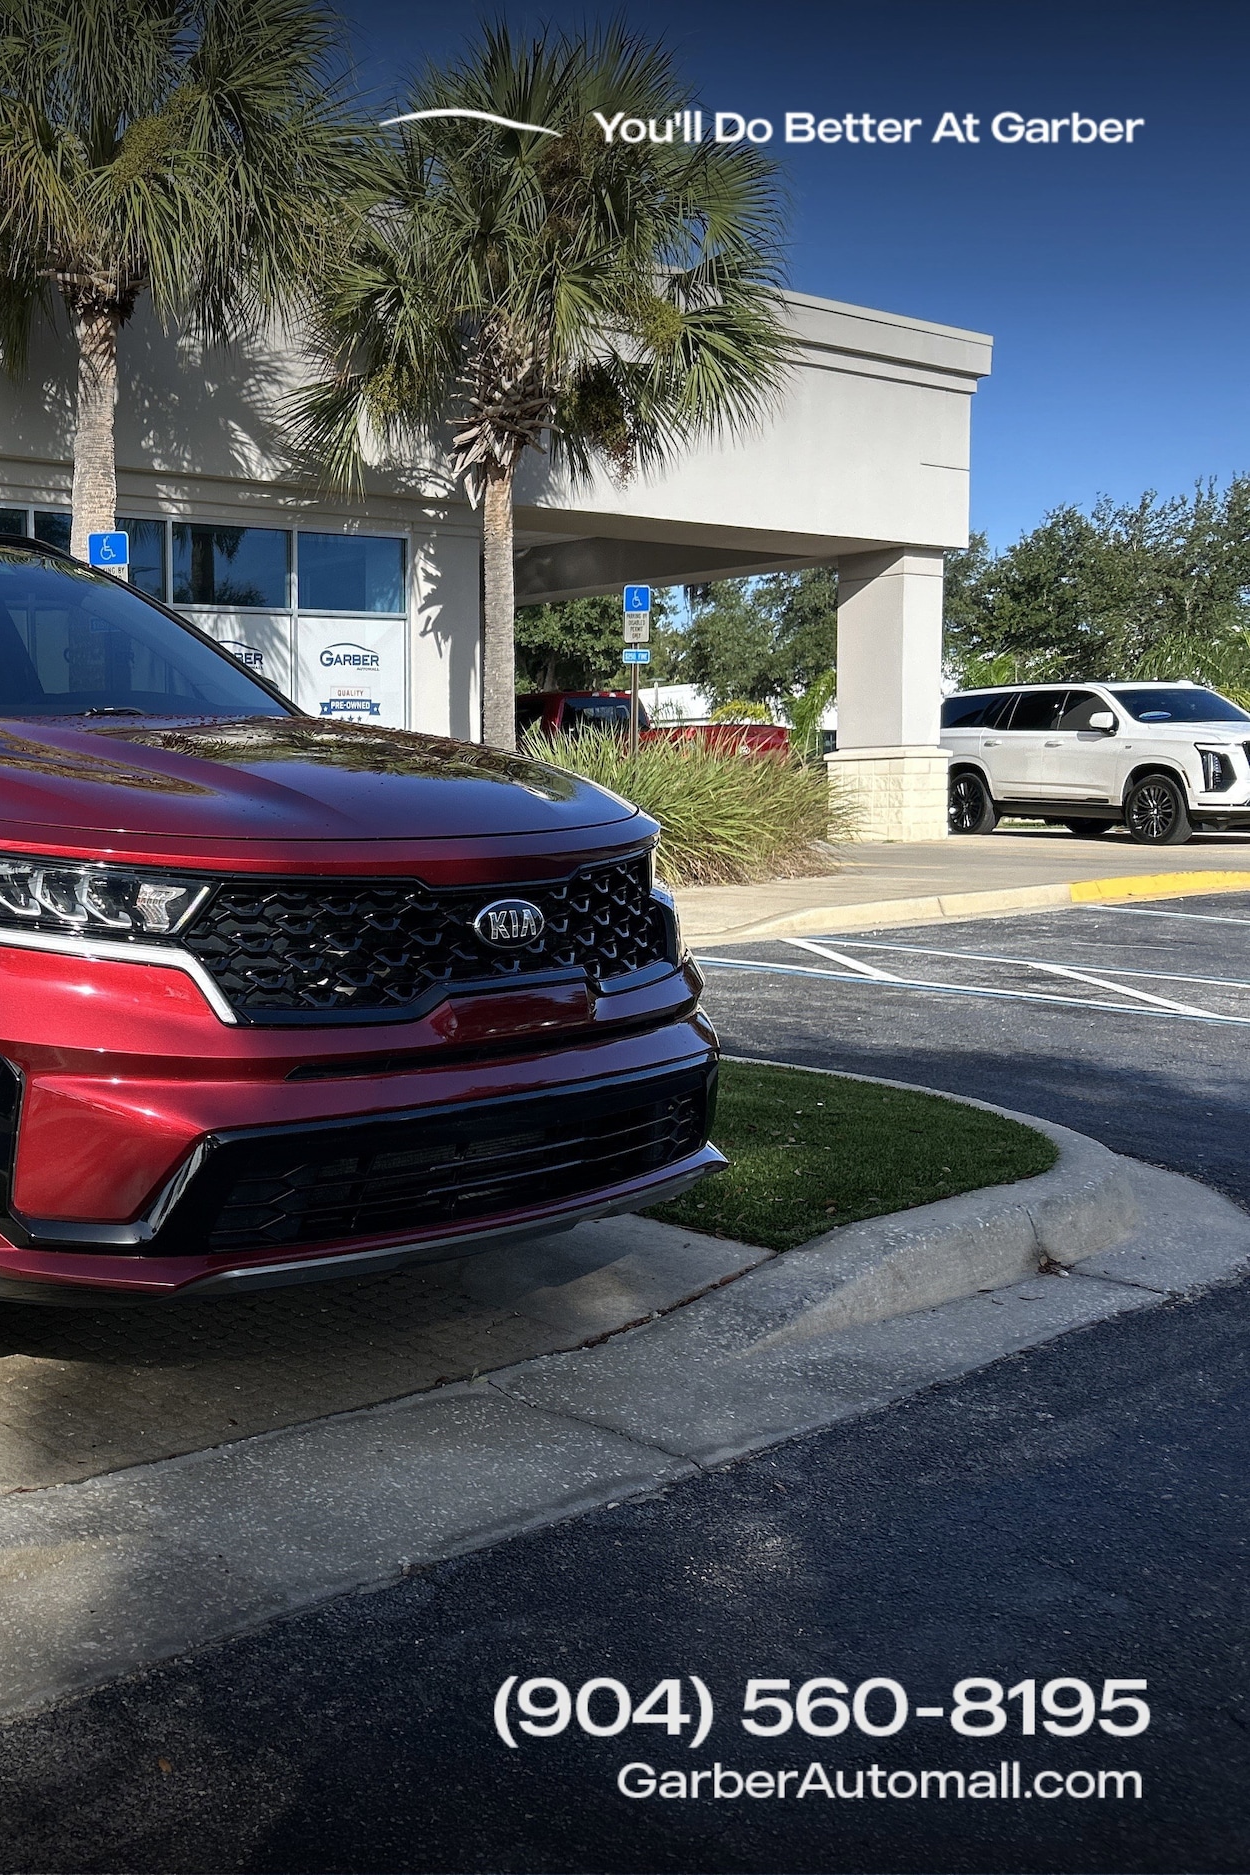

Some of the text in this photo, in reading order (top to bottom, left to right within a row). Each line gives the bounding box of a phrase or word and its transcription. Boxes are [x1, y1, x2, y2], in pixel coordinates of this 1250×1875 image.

[320, 650, 380, 667] GARBER
[337, 689, 364, 697] QUALITY
[330, 701, 371, 711] PRE-OWNED
[488, 908, 537, 940] KIA
